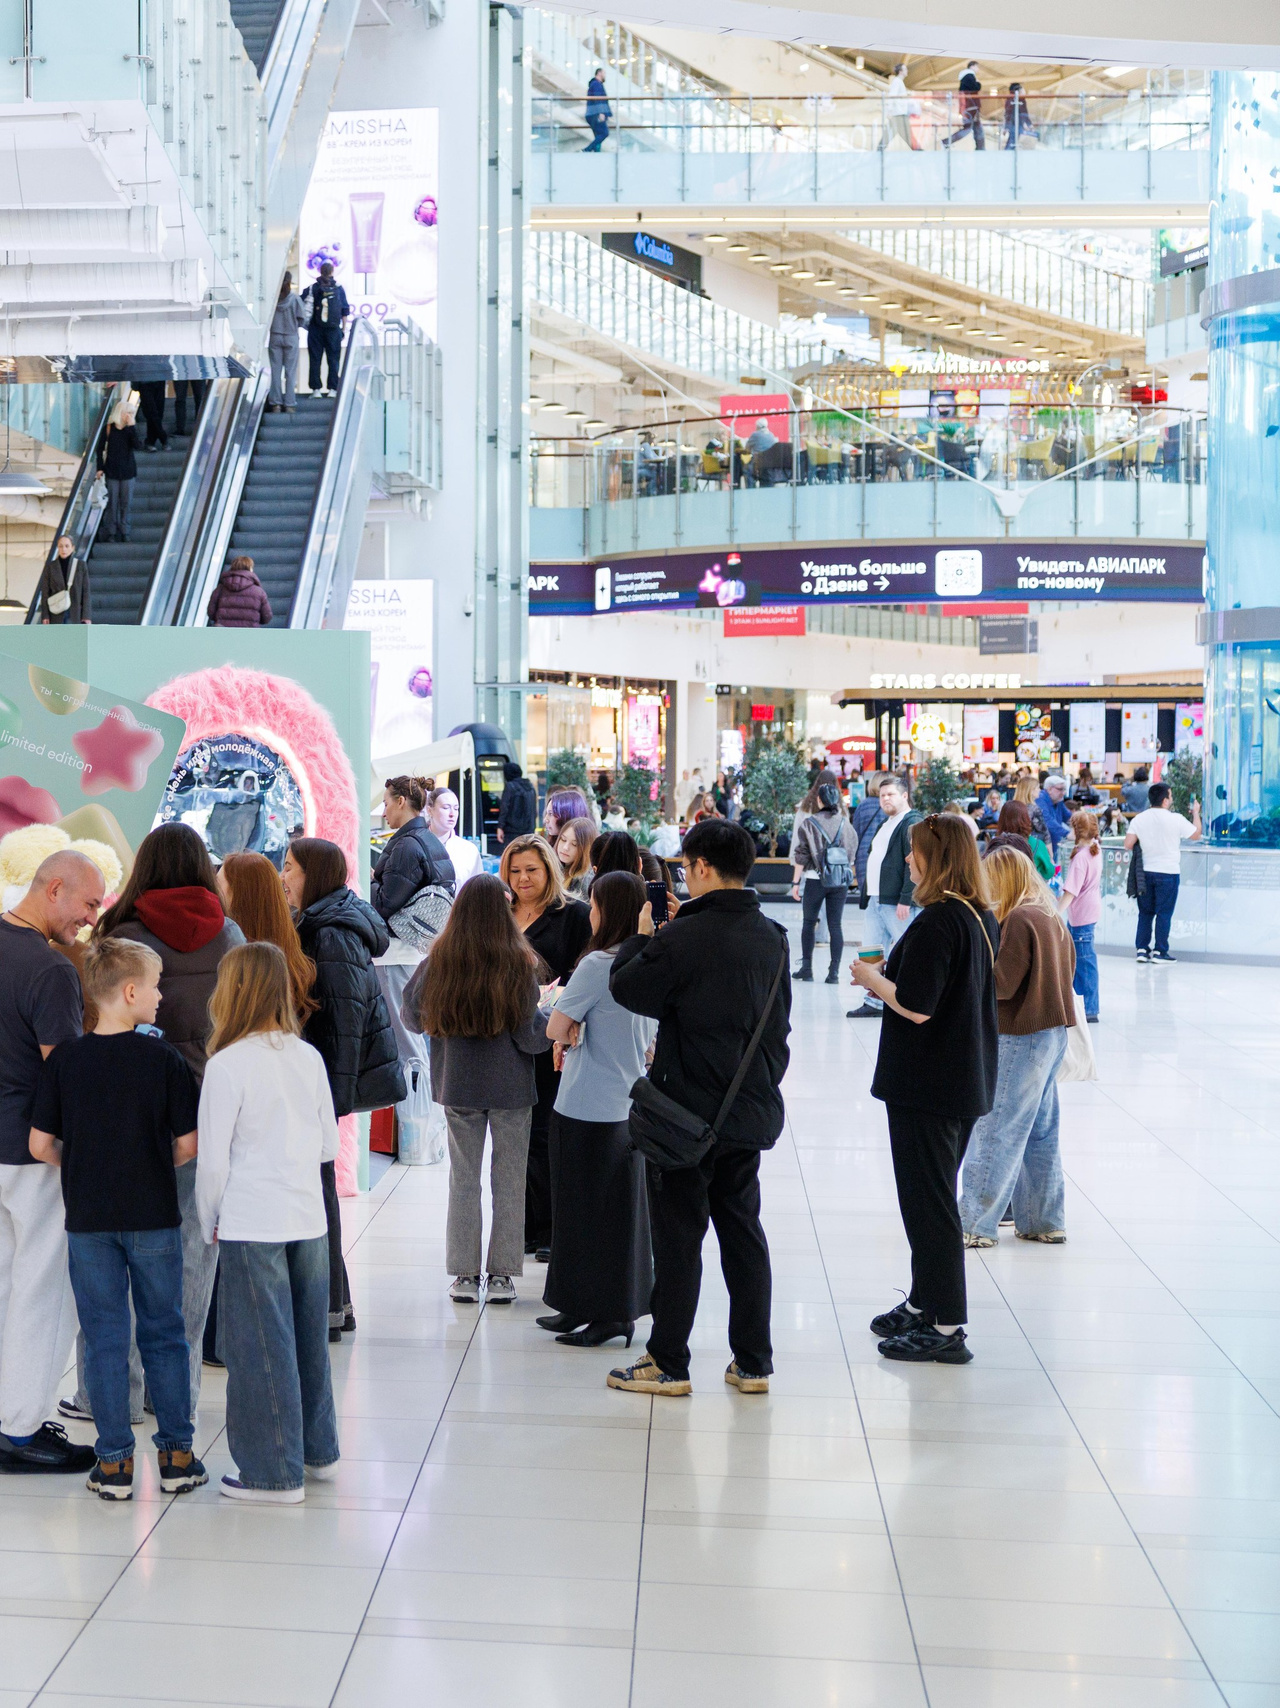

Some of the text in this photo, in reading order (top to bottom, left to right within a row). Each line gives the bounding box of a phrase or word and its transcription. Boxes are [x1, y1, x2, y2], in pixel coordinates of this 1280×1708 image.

[330, 118, 408, 135] MISSHA
[642, 235, 674, 266] Columbia
[910, 359, 1050, 374] ЛАЛИБЕЛА КОФЕ
[800, 559, 927, 577] Узнать больше
[1017, 556, 1166, 575] Увидеть АВИАПАРК
[800, 576, 868, 595] о Дзене
[1017, 576, 1105, 593] по-новому
[350, 589, 402, 604] SSHA
[348, 608, 407, 617] ЕМ ИЗ КОРЕИ
[870, 673, 1021, 690] STARS COFFEE
[40, 686, 53, 697] ты
[0, 729, 47, 756] limited
[47, 747, 94, 774] edition
[211, 743, 276, 770] молодёжная
